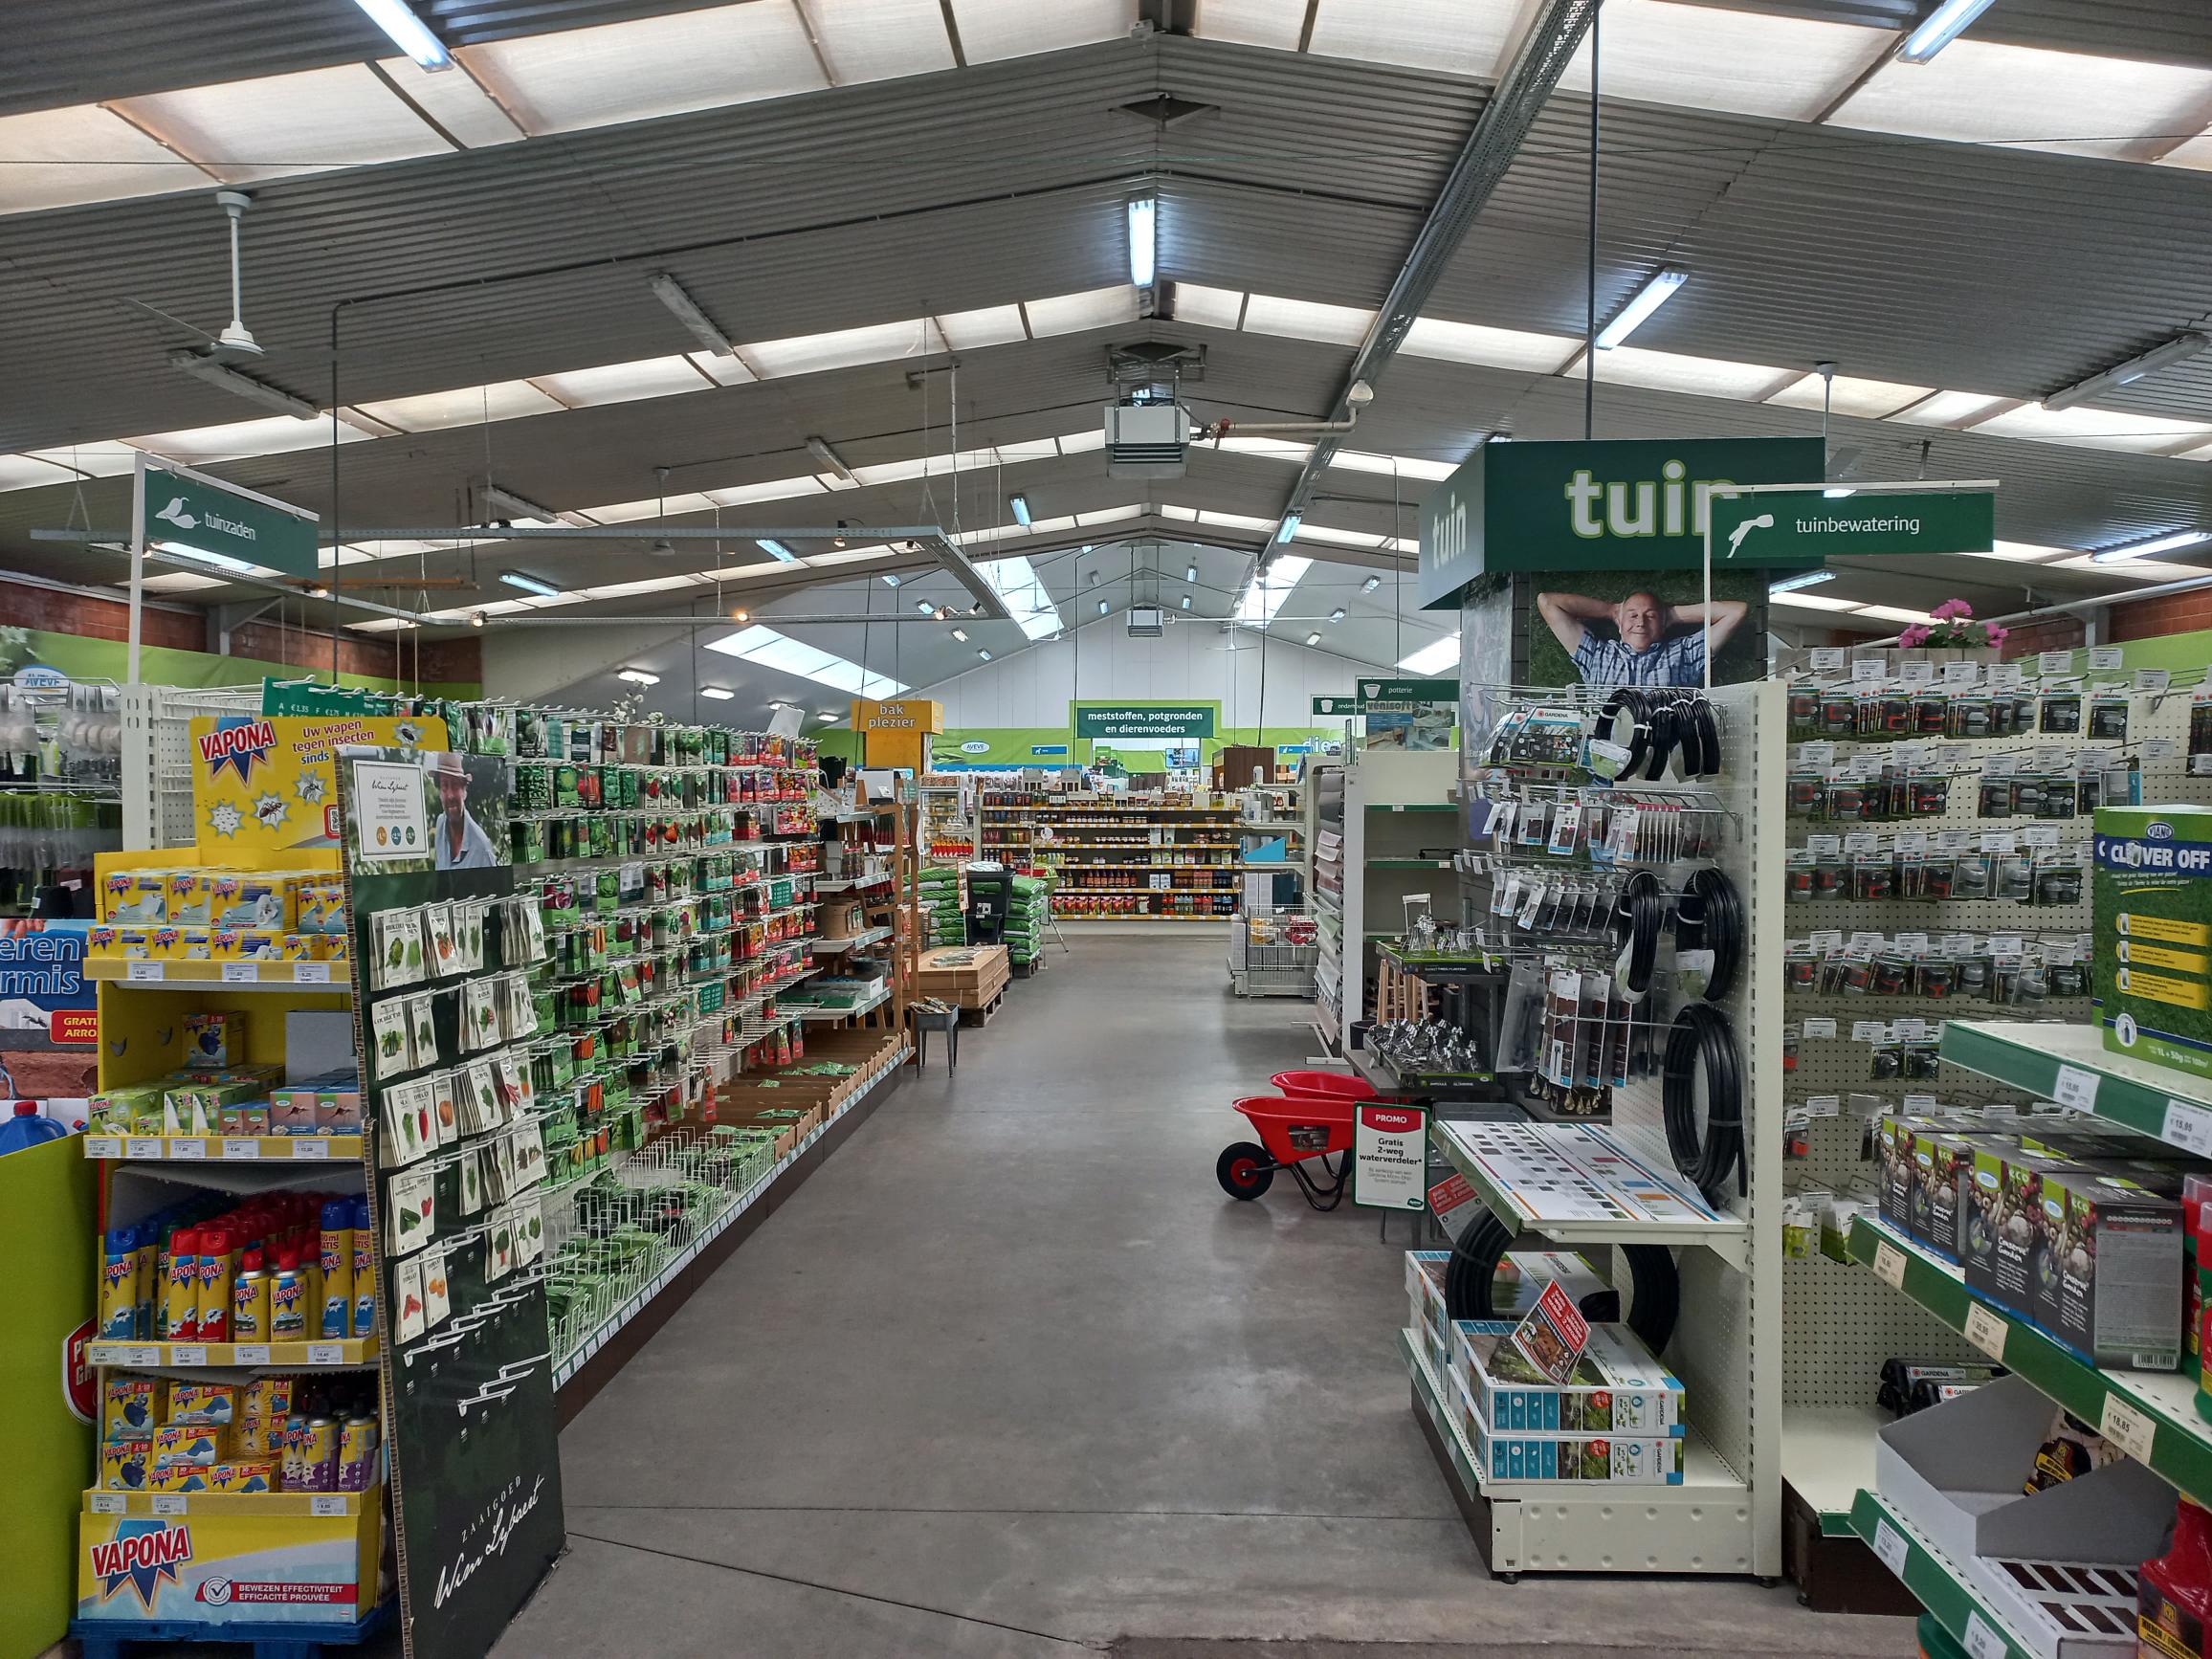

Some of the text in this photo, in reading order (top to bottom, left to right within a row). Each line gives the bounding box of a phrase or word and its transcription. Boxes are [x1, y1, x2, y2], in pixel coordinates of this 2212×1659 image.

[205, 511, 256, 542] tuinzaden
[1432, 491, 1468, 568] tuin
[1796, 516, 1920, 535] tuinbewatering
[1388, 686, 1413, 695] potterie
[879, 704, 904, 715] bak
[1088, 711, 1203, 722] meststoffen, potgronden
[302, 720, 362, 739] Uw wapen
[869, 717, 916, 728] plezier
[1118, 724, 1185, 734] dierenvoeders
[198, 720, 276, 763] VAPONA
[293, 730, 374, 753] tegen insecten
[300, 750, 330, 765] sinds
[2149, 825, 2173, 839] VIANO
[2111, 843, 2211, 870] CLVER OFF
[106, 876, 132, 890] VAPONA
[169, 876, 197, 892] VAPONA
[210, 880, 238, 894] VAPONA
[90, 930, 116, 942] VAPONA
[151, 930, 179, 943] VAPONA
[211, 932, 238, 945] VAPONA
[0, 937, 79, 962] eren
[89, 1100, 112, 1112] VAPONA
[1375, 1114, 1407, 1124] PROMO
[2176, 1119, 2193, 1133] 15,95
[1378, 1138, 1404, 1147] Gratis
[1378, 1146, 1404, 1157] 2-weg
[107, 1384, 134, 1398] VAPONA
[173, 1388, 199, 1403] VAPONA
[2112, 1415, 2131, 1433] 18,85
[156, 1430, 183, 1444] VAPONA
[104, 1444, 131, 1457] VAPONA
[148, 1469, 174, 1482] VAPONA
[210, 1469, 236, 1482] VAPONA
[461, 1476, 521, 1543] ZAAIGOED
[92, 1525, 190, 1578] VAPONA
[239, 1584, 343, 1593] BEWEZEN EFFECTIVITEIT
[239, 1592, 330, 1602] EFFICACITÉ PROUVÉE
